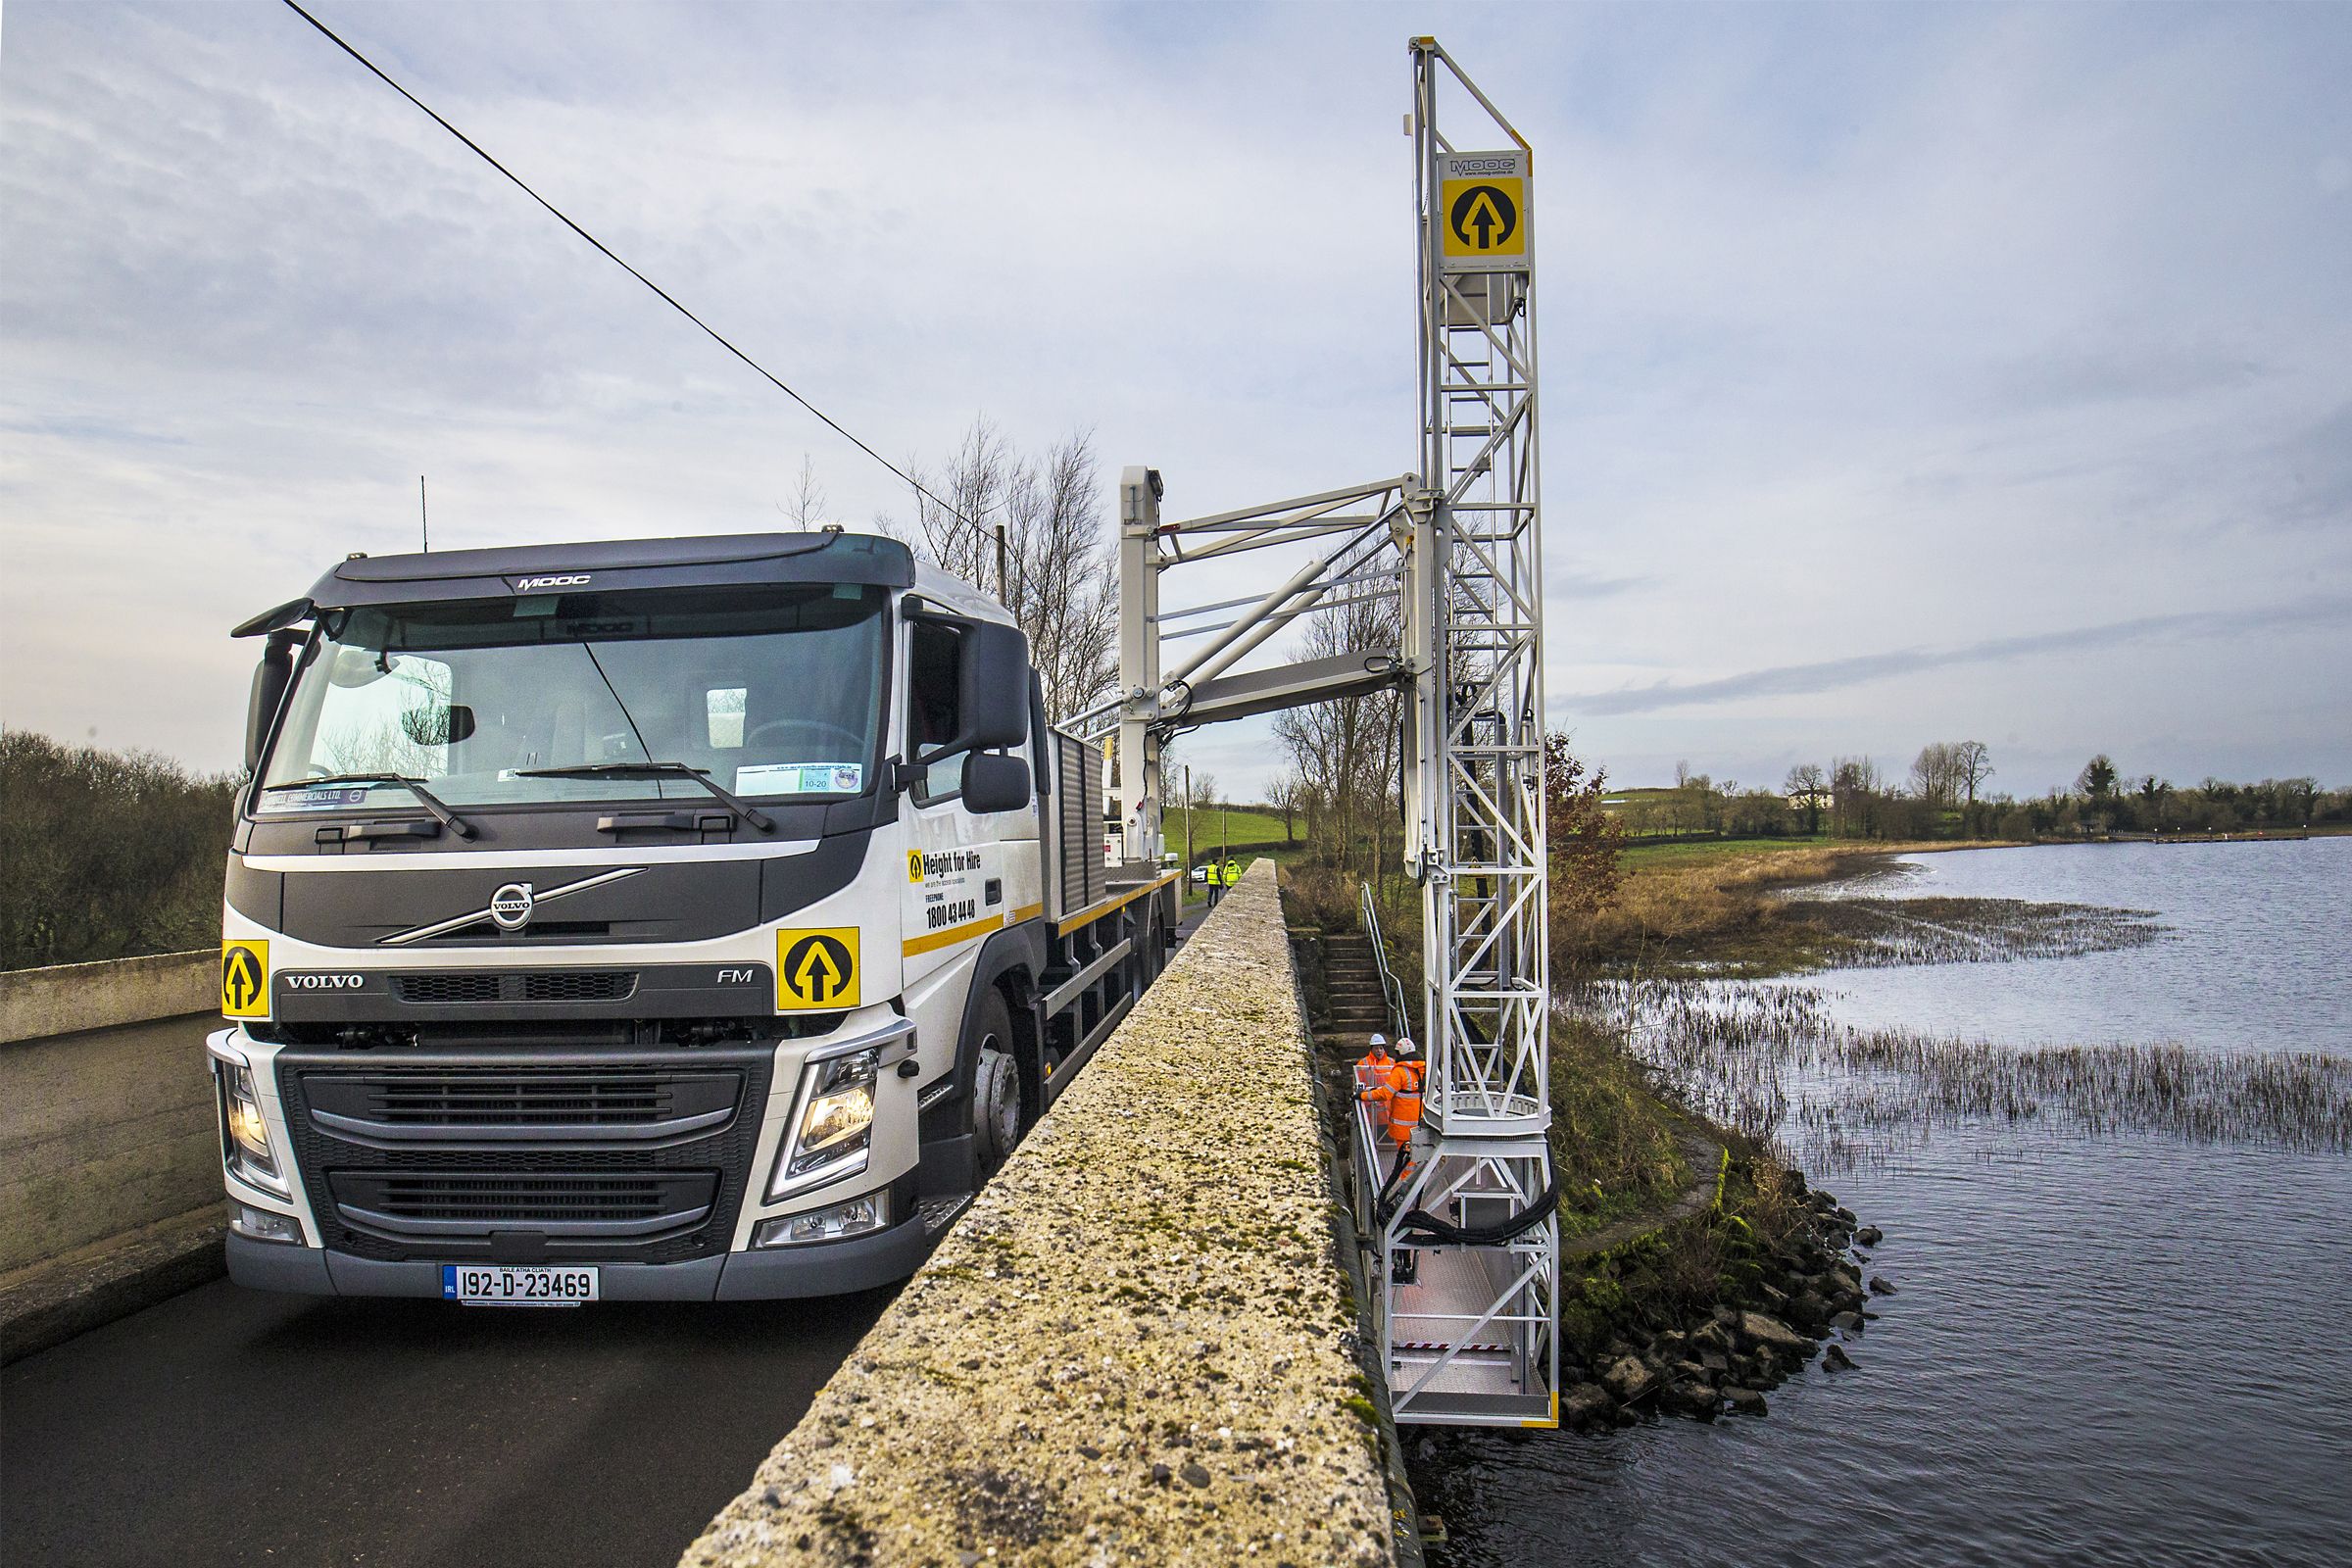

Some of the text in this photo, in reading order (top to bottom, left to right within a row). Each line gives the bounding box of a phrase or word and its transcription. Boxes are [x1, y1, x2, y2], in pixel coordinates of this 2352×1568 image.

[287, 791, 327, 802] COMMERCIALS
[922, 851, 981, 878] Height for Hire
[925, 892, 944, 903] FREEPHONE
[926, 899, 975, 929] 1800 43 44 48
[285, 975, 364, 989] VOLVO
[716, 969, 754, 983] FM
[462, 1272, 591, 1298] 192-D-23469
